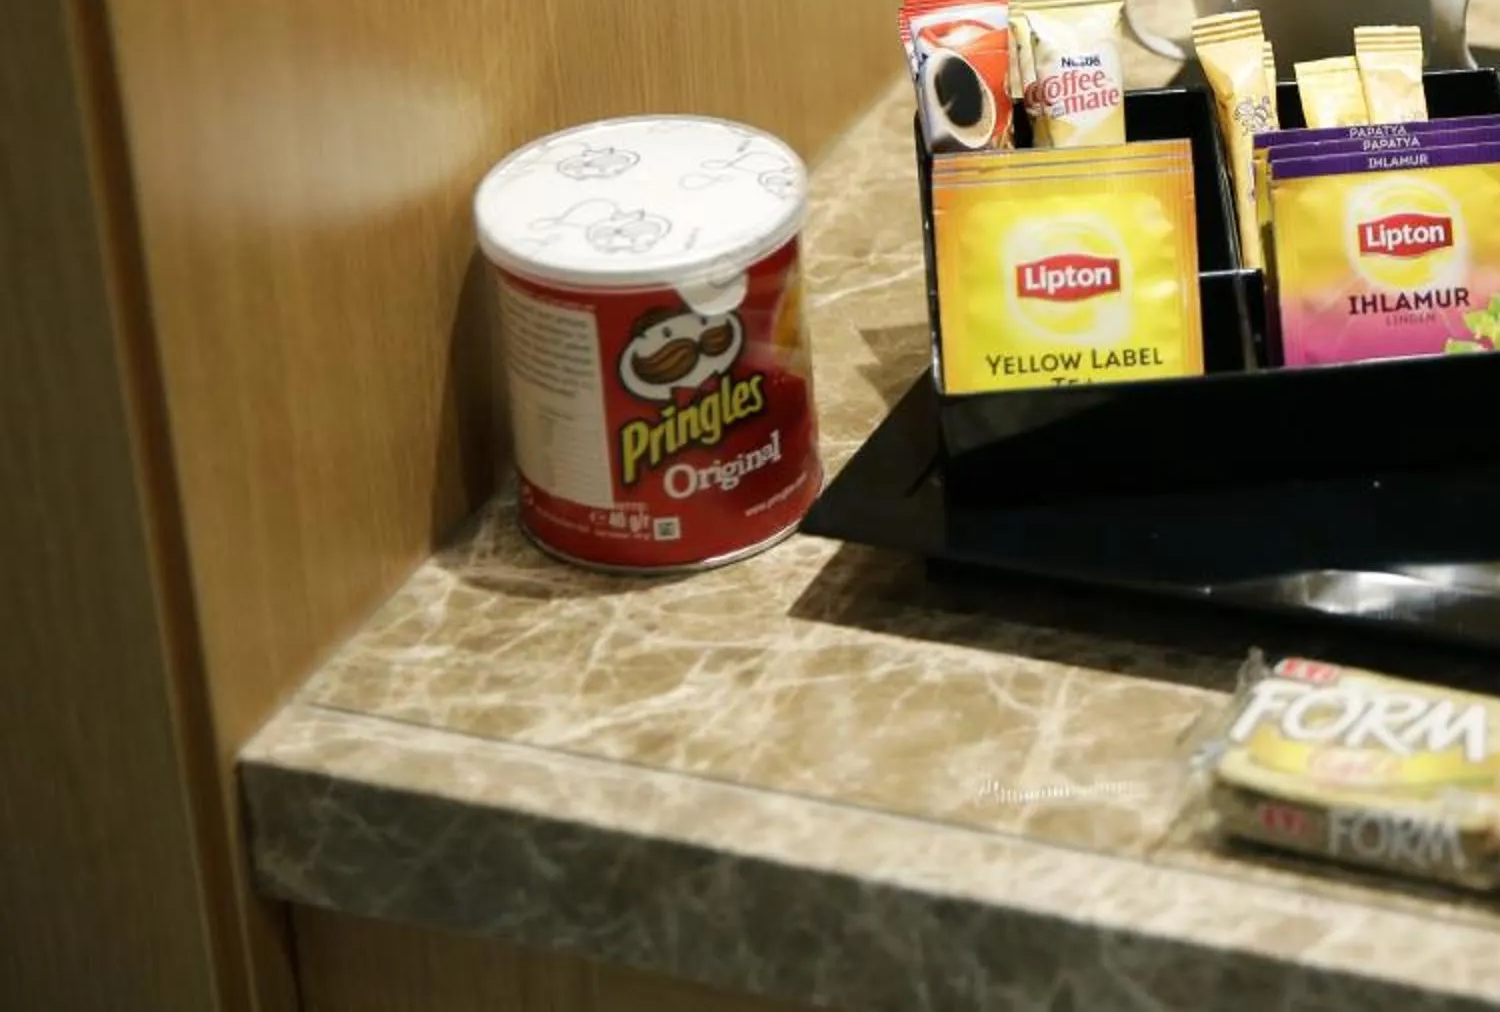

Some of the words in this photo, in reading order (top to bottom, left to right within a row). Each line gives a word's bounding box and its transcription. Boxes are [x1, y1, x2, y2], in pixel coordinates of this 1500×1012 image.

[1043, 70, 1105, 106] Coffee
[1064, 88, 1120, 114] mate
[1363, 136, 1420, 151] PAPATYA
[1369, 153, 1429, 169] IHLAMUR
[1365, 223, 1445, 250] Lipton
[1024, 264, 1112, 295] Lipton
[1348, 287, 1470, 315] IHLAMUR
[985, 352, 1082, 376] YELLOW
[1091, 348, 1163, 370] LABEL
[622, 374, 764, 484] Pringles
[664, 429, 782, 499] Original
[1229, 677, 1487, 763] FORM
[1327, 807, 1465, 870] FORM
